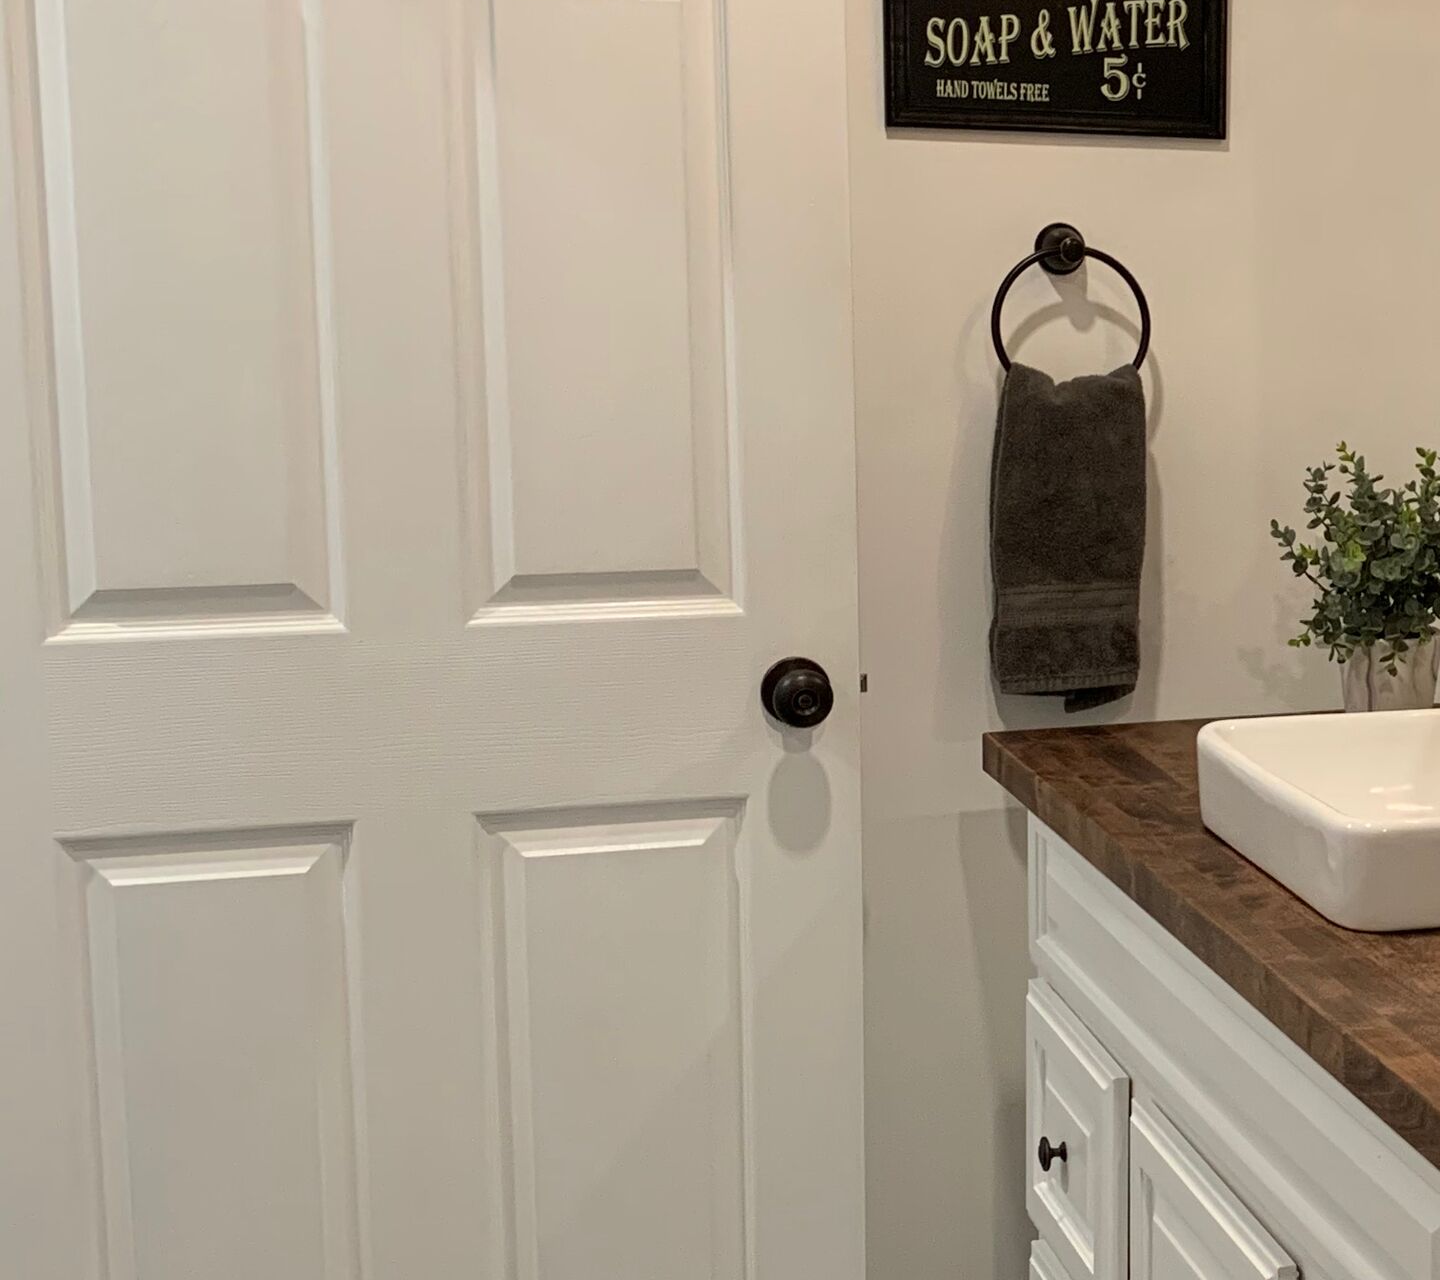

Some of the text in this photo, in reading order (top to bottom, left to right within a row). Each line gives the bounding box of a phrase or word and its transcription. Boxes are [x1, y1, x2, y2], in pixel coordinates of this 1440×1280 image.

[924, 14, 1021, 66] SOAP
[1030, 9, 1057, 60] &
[936, 79, 1050, 103] HAND TOWELS FREE
